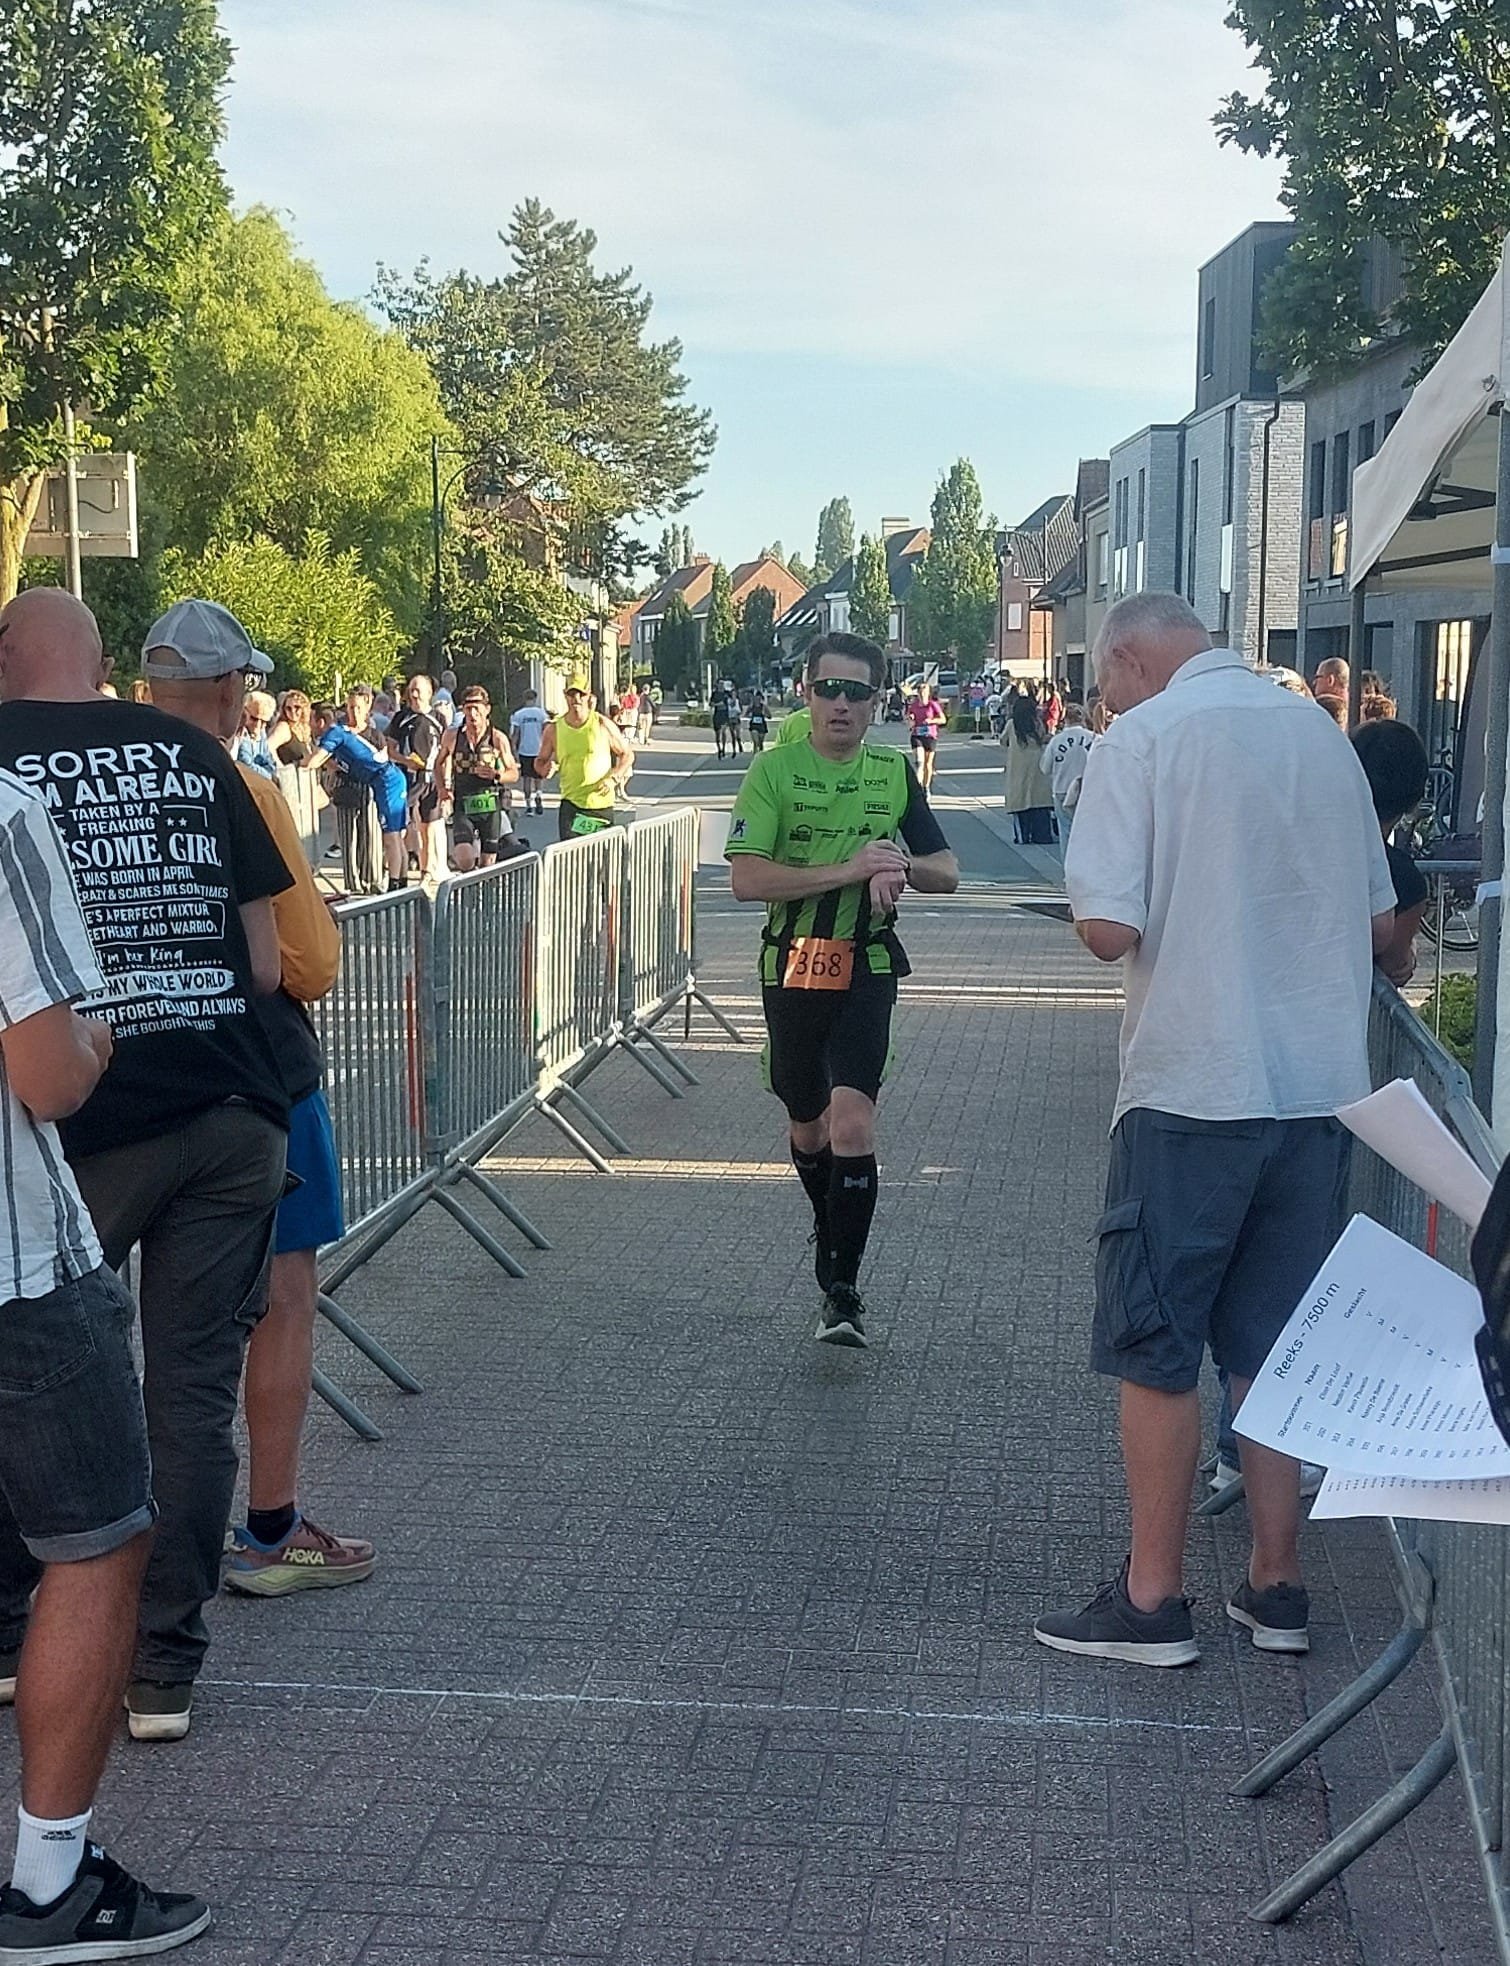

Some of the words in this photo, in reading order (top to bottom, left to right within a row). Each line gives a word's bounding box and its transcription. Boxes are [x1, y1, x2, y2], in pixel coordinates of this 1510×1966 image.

[15, 742, 184, 783] SORRY
[75, 770, 216, 806] ALREADY
[68, 804, 121, 822] TAKEN
[123, 803, 144, 817] BY
[149, 802, 160, 815] A
[78, 817, 155, 837] FREAKING
[65, 833, 163, 870] SOME
[168, 832, 223, 868] GIRL
[82, 871, 109, 887] WAS
[110, 868, 145, 885] BORN
[146, 866, 161, 882] IN
[163, 865, 195, 881] APRIL
[79, 889, 107, 903] RAZY
[118, 884, 161, 900] SCARES
[113, 905, 164, 923] PERFECT
[168, 902, 210, 918] MIXTUR
[143, 923, 168, 938] AND
[796, 951, 842, 977] 368
[108, 976, 128, 997] MY
[178, 971, 226, 992] WORLD
[202, 997, 246, 1016] ALWAYS
[115, 1023, 139, 1039] SHE
[193, 1019, 217, 1031] THIS
[1273, 1338, 1303, 1379] Reeks
[1300, 1296, 1328, 1330] 7500
[1325, 1282, 1340, 1297] m
[282, 1547, 325, 1566] HOKA
